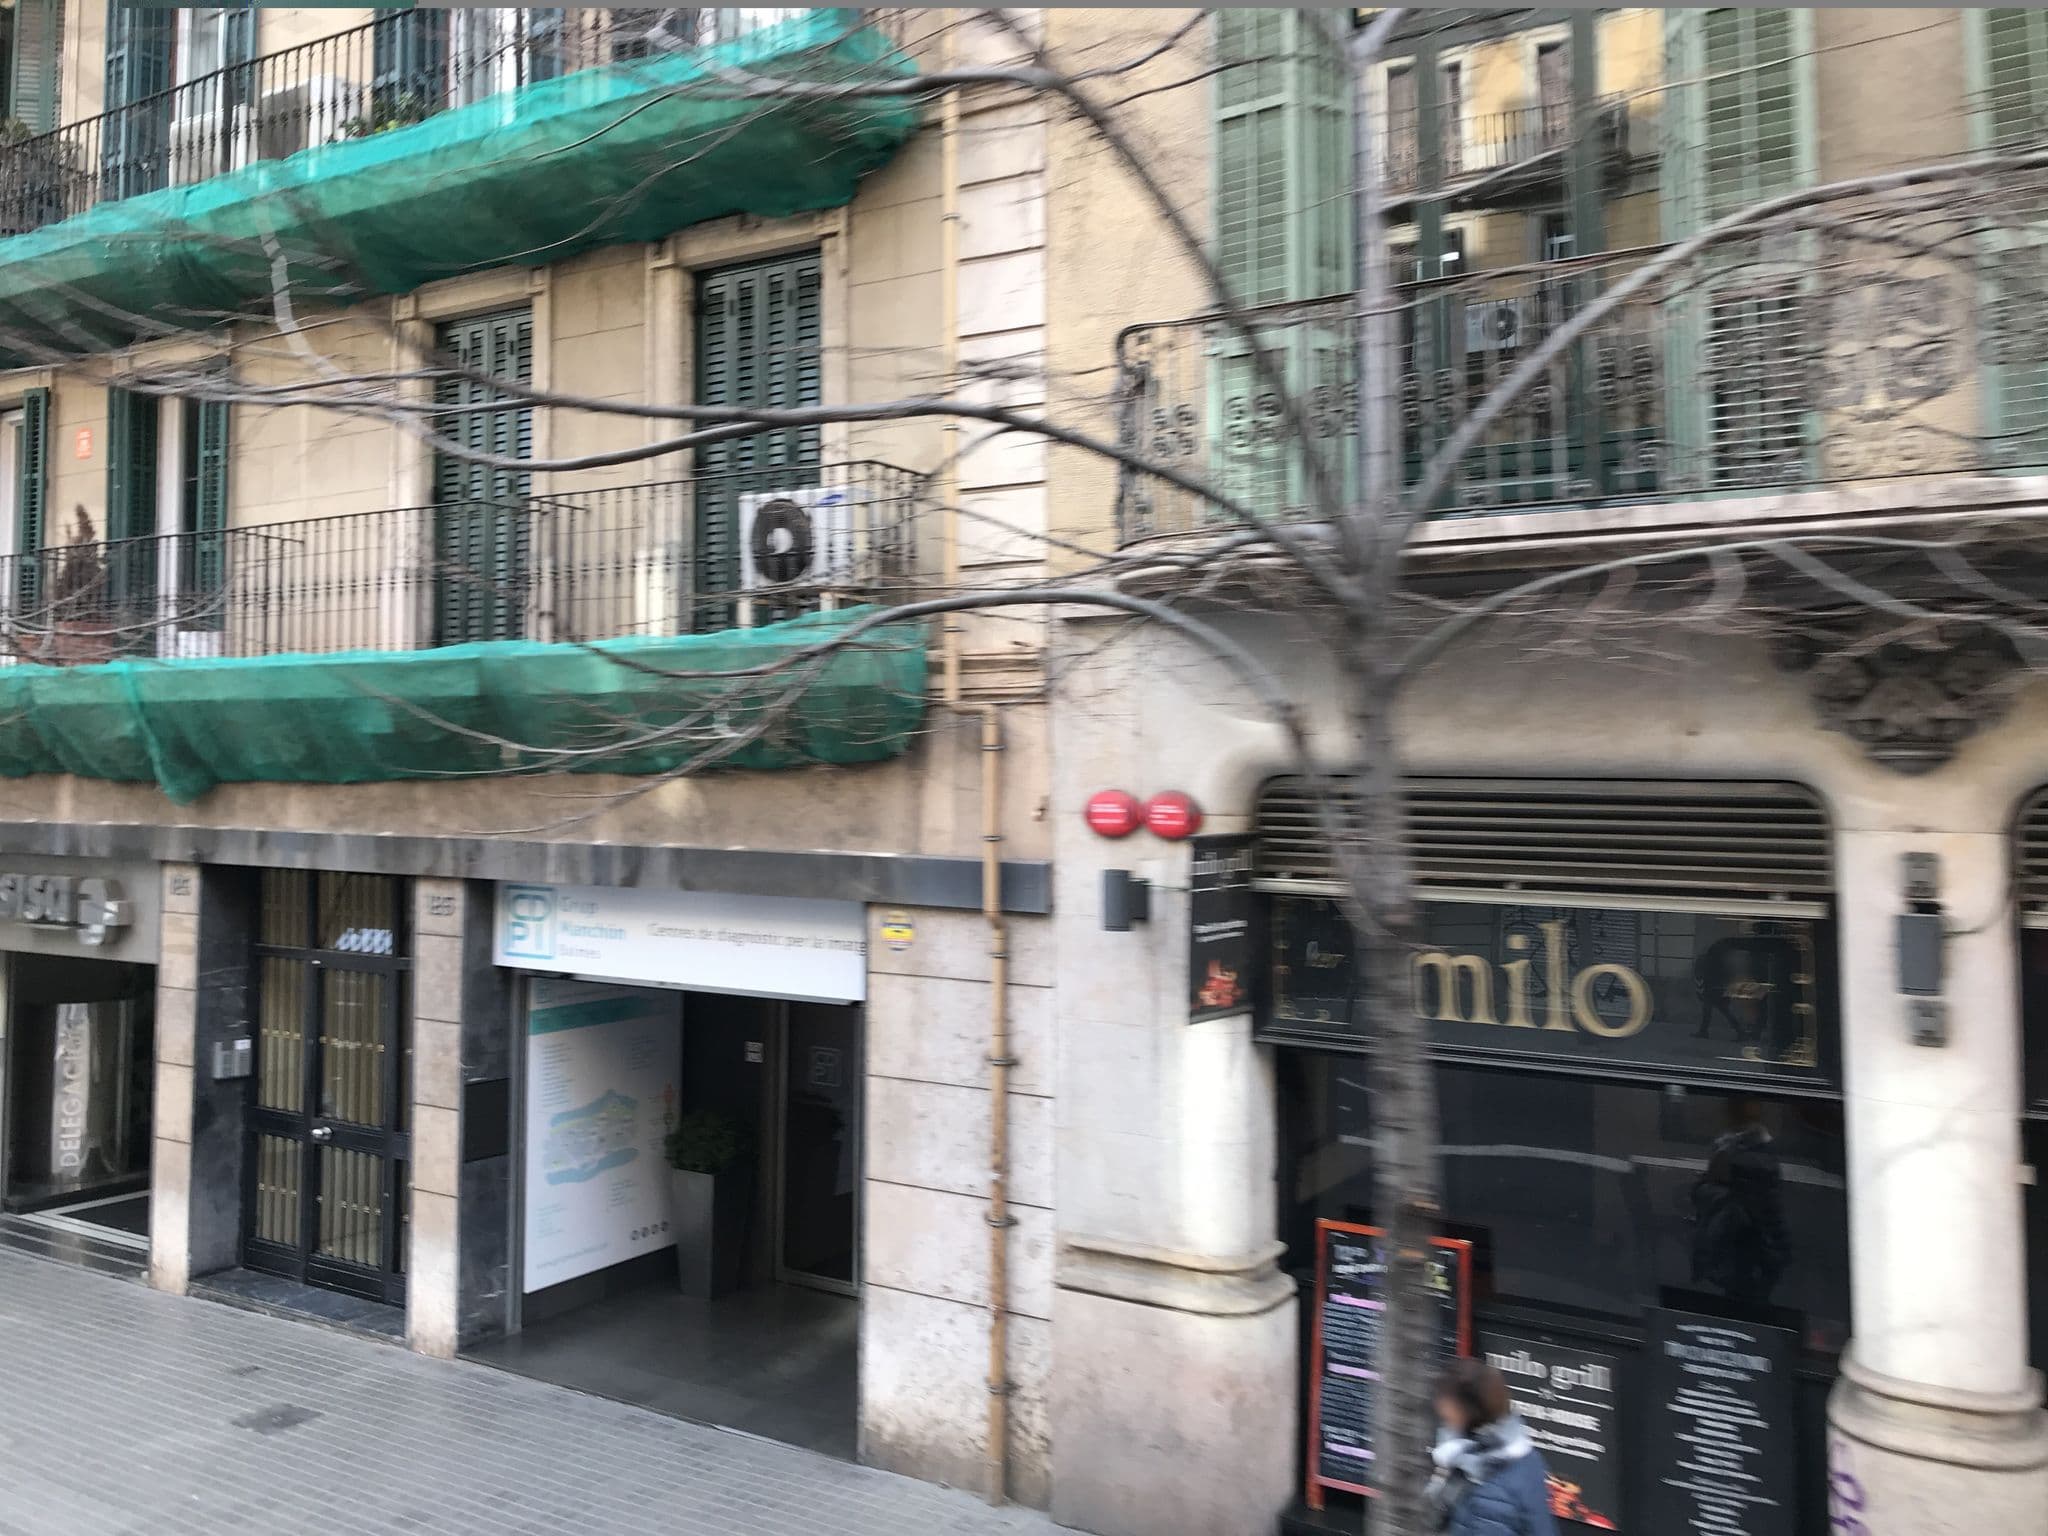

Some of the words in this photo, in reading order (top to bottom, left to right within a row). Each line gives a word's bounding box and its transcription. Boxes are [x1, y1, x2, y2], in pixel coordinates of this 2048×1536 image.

[1412, 919, 1654, 1039] milo
[1485, 1350, 1548, 1379] milo
[1550, 1363, 1613, 1391] grill
